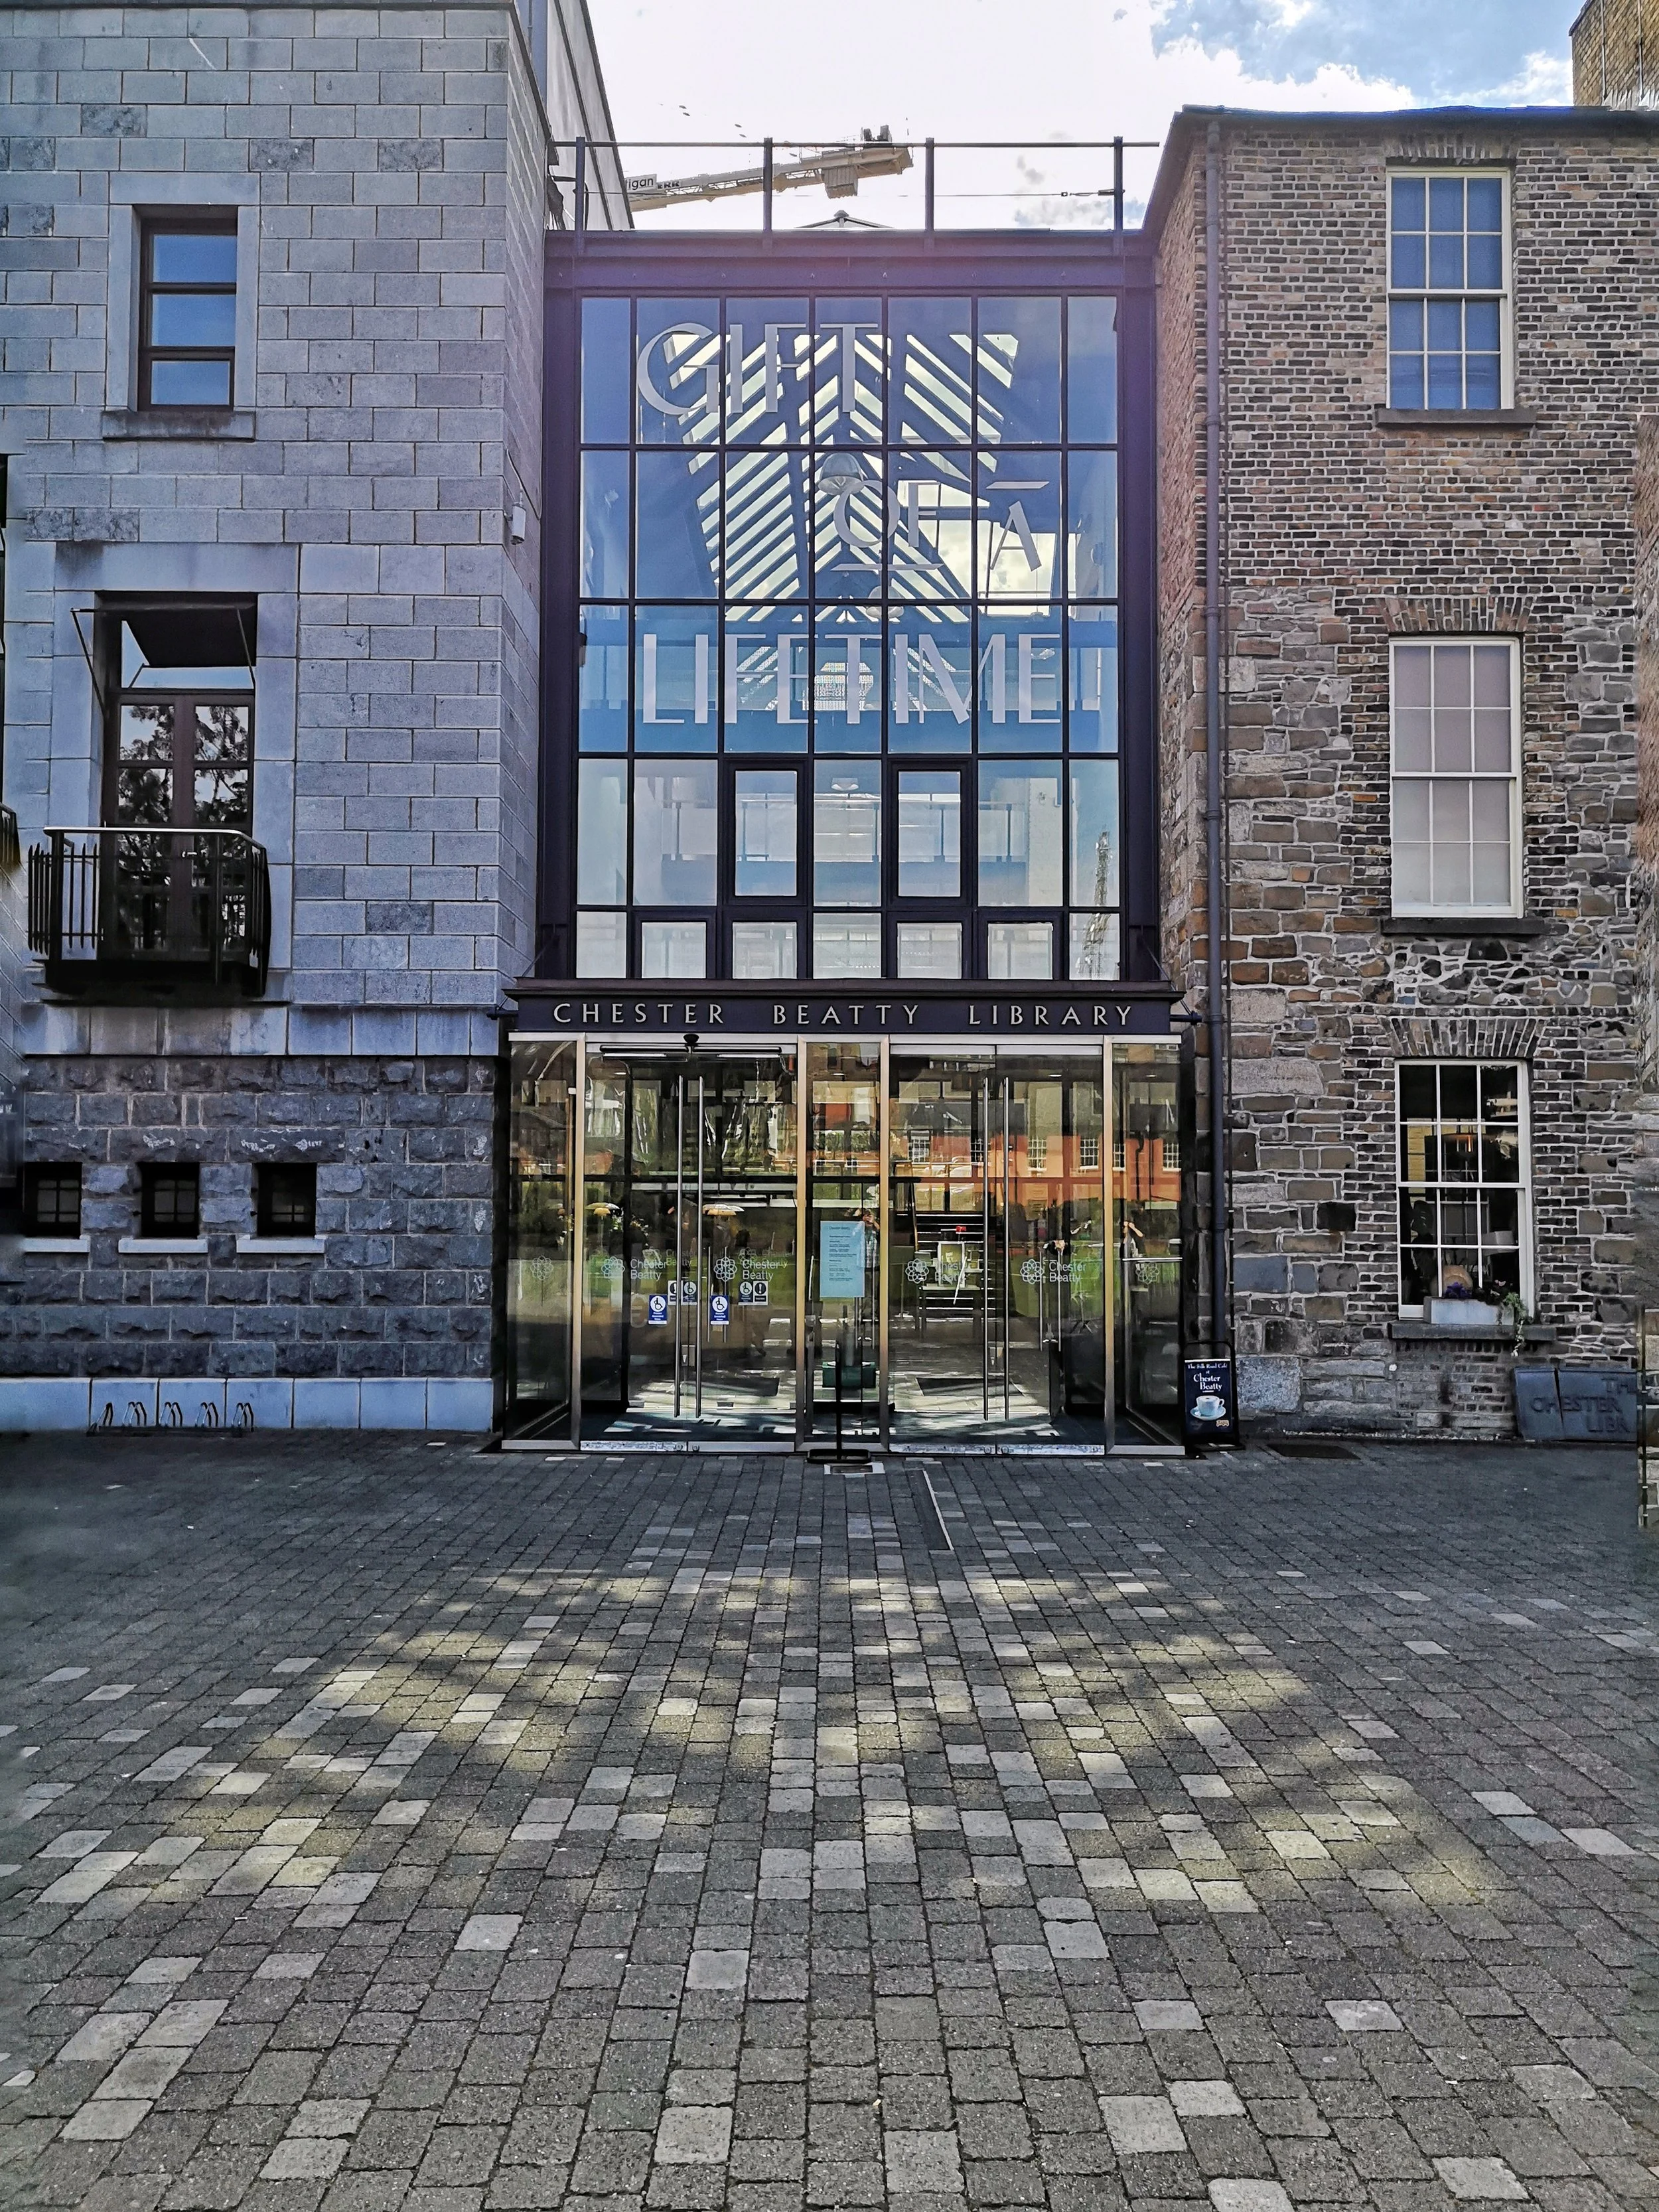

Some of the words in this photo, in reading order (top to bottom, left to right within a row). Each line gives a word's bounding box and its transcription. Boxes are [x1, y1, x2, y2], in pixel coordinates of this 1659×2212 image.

[625, 177, 654, 190] igan
[636, 323, 879, 416] GIFT
[833, 479, 941, 548] OF
[990, 500, 1041, 572] A
[642, 633, 1062, 725] LIFETIME
[553, 1003, 724, 1024] CHESTER
[772, 1004, 918, 1025] BEATTY
[968, 1004, 1131, 1026] LIBRARY
[630, 1258, 667, 1269] Chester
[743, 1258, 780, 1270] Chester
[1049, 1261, 1086, 1272] Chester
[630, 1269, 662, 1282] Beatty
[743, 1270, 774, 1282] Beatty
[1049, 1272, 1081, 1286] Beatty
[1193, 1372, 1221, 1382] Chester
[1200, 1382, 1222, 1392] Beatty
[1530, 1396, 1623, 1414] CHESTER
